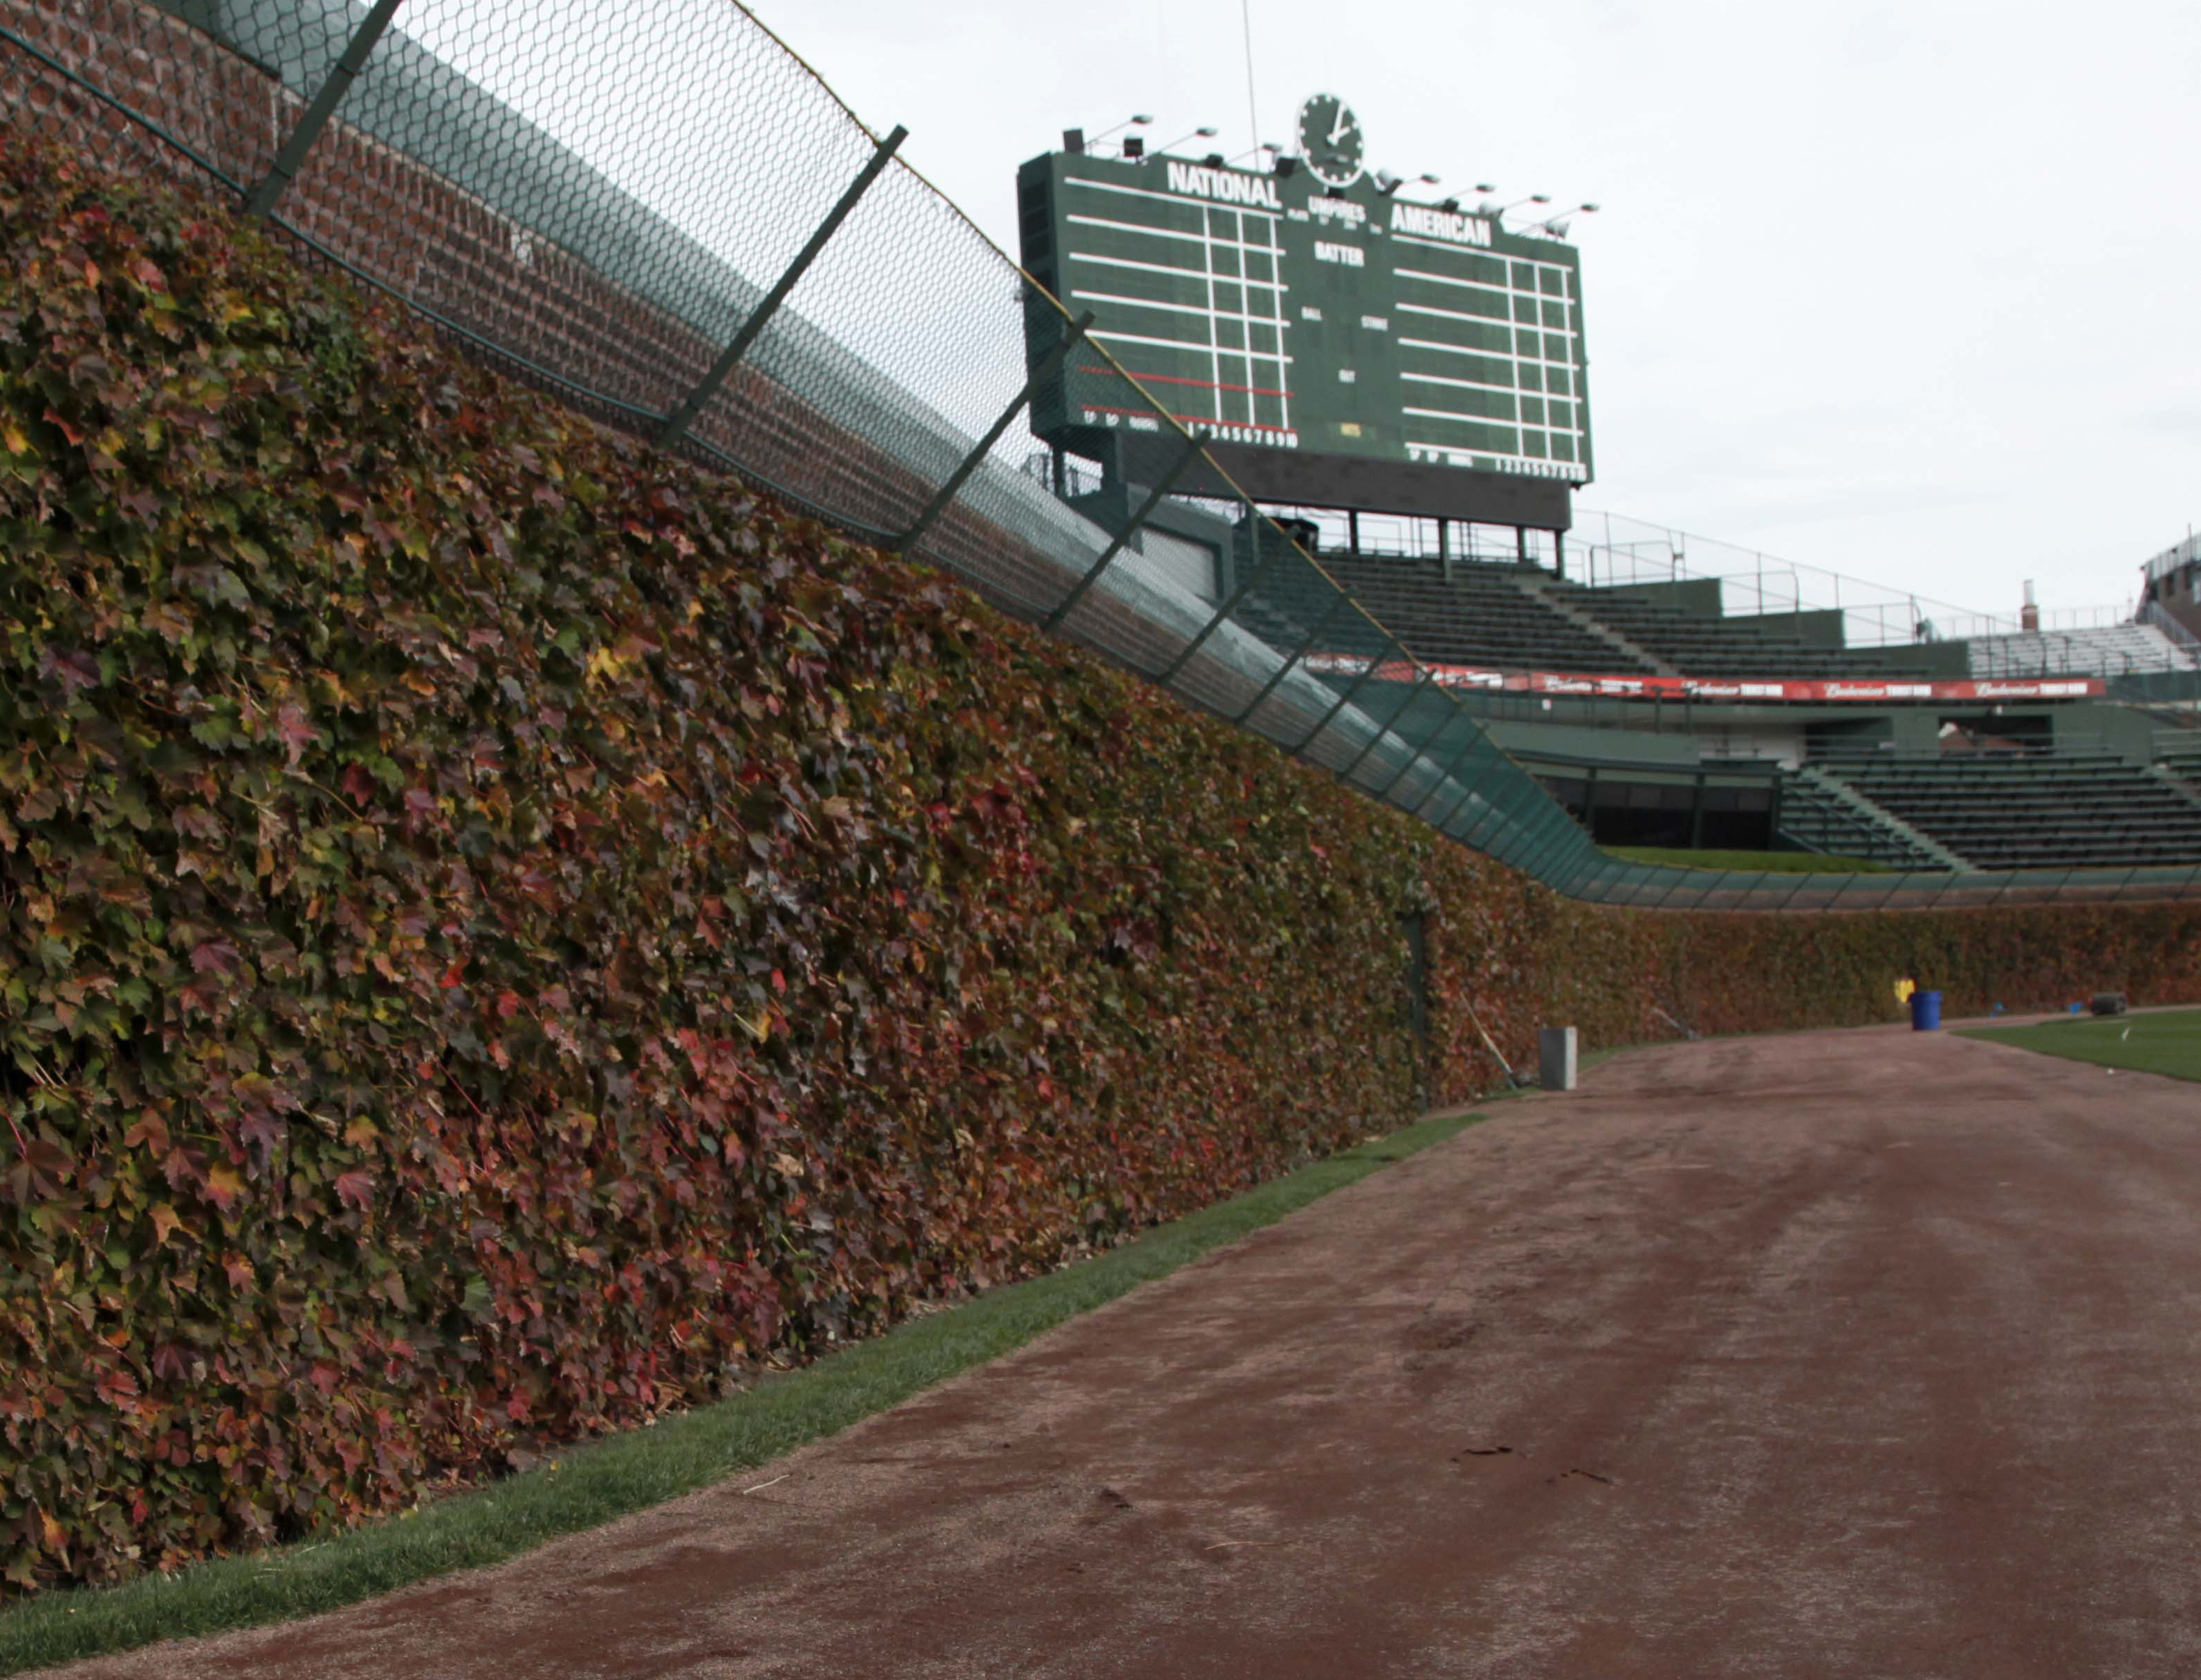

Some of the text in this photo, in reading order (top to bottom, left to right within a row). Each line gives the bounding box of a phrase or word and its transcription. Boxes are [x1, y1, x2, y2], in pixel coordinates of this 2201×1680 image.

[1166, 161, 1283, 210] NATIONAL
[1390, 202, 1492, 248] AMERICAN
[1314, 240, 1365, 268] BATTER
[1221, 425, 1230, 441] 4
[1232, 426, 1241, 442] 5
[1243, 427, 1253, 444] 6
[1254, 429, 1262, 445] 7
[1265, 430, 1275, 446] 8
[1276, 431, 1285, 447] 9
